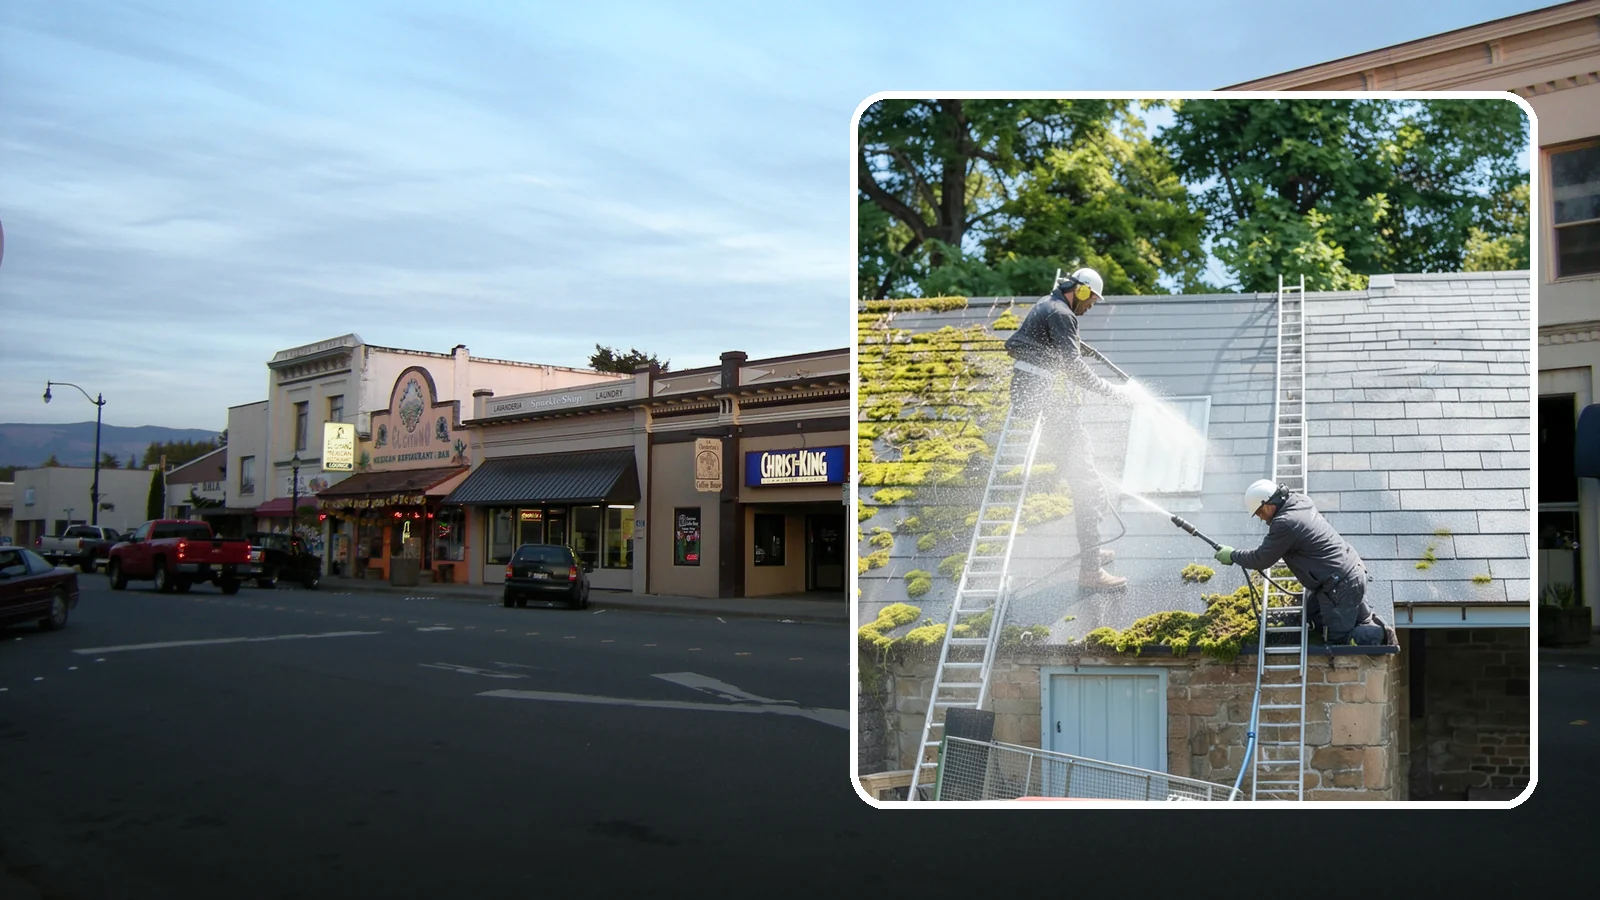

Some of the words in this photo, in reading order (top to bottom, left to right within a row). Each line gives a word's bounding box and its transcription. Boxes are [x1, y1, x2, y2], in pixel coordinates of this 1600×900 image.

[493, 402, 522, 413] LAVANDERIA
[530, 396, 561, 409] Sparkle
[561, 394, 583, 405] Shop
[595, 389, 624, 400] LAUNDRY
[373, 454, 396, 464] MEXICAN
[397, 451, 433, 462] RESTAURANT
[438, 450, 450, 459] BAR
